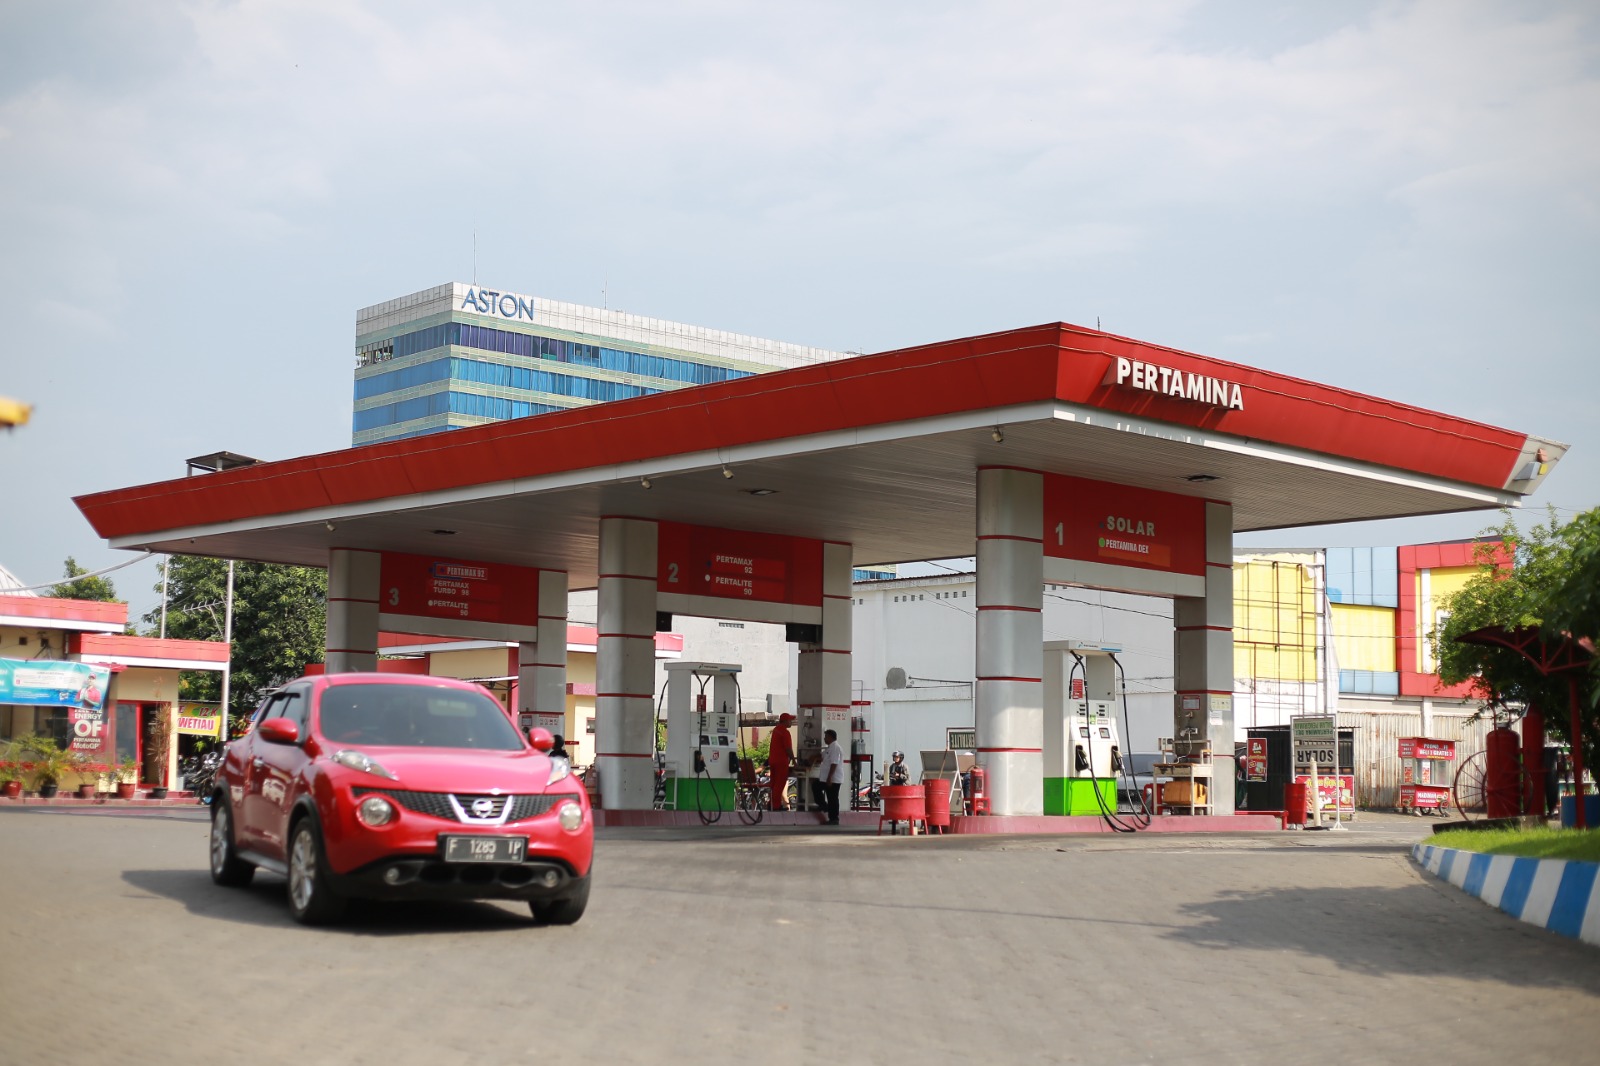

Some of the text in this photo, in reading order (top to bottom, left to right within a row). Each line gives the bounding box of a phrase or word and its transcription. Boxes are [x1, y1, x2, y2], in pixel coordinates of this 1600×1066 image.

[462, 288, 534, 320] ASTON
[1117, 357, 1243, 410] PERTAMINA
[1107, 516, 1155, 536] SOLAR
[1055, 522, 1064, 546] 1
[1105, 539, 1149, 554] PERTAMINA DEX
[716, 555, 753, 566] PERTAMAX
[447, 566, 485, 578] PERTAMAX 92
[667, 563, 679, 583] 2
[434, 579, 469, 589] PERTAMAX
[715, 576, 752, 588] PERTALITE
[388, 587, 399, 606] 3
[433, 586, 456, 595] TURBO
[433, 600, 468, 609] PERTALITE
[199, 707, 209, 716] 12
[210, 708, 218, 717] K
[74, 720, 102, 737] OF
[178, 717, 215, 731] WETIAU
[951, 733, 976, 748] ERTALITE
[1297, 750, 1334, 763] SOLAR
[449, 839, 458, 854] F
